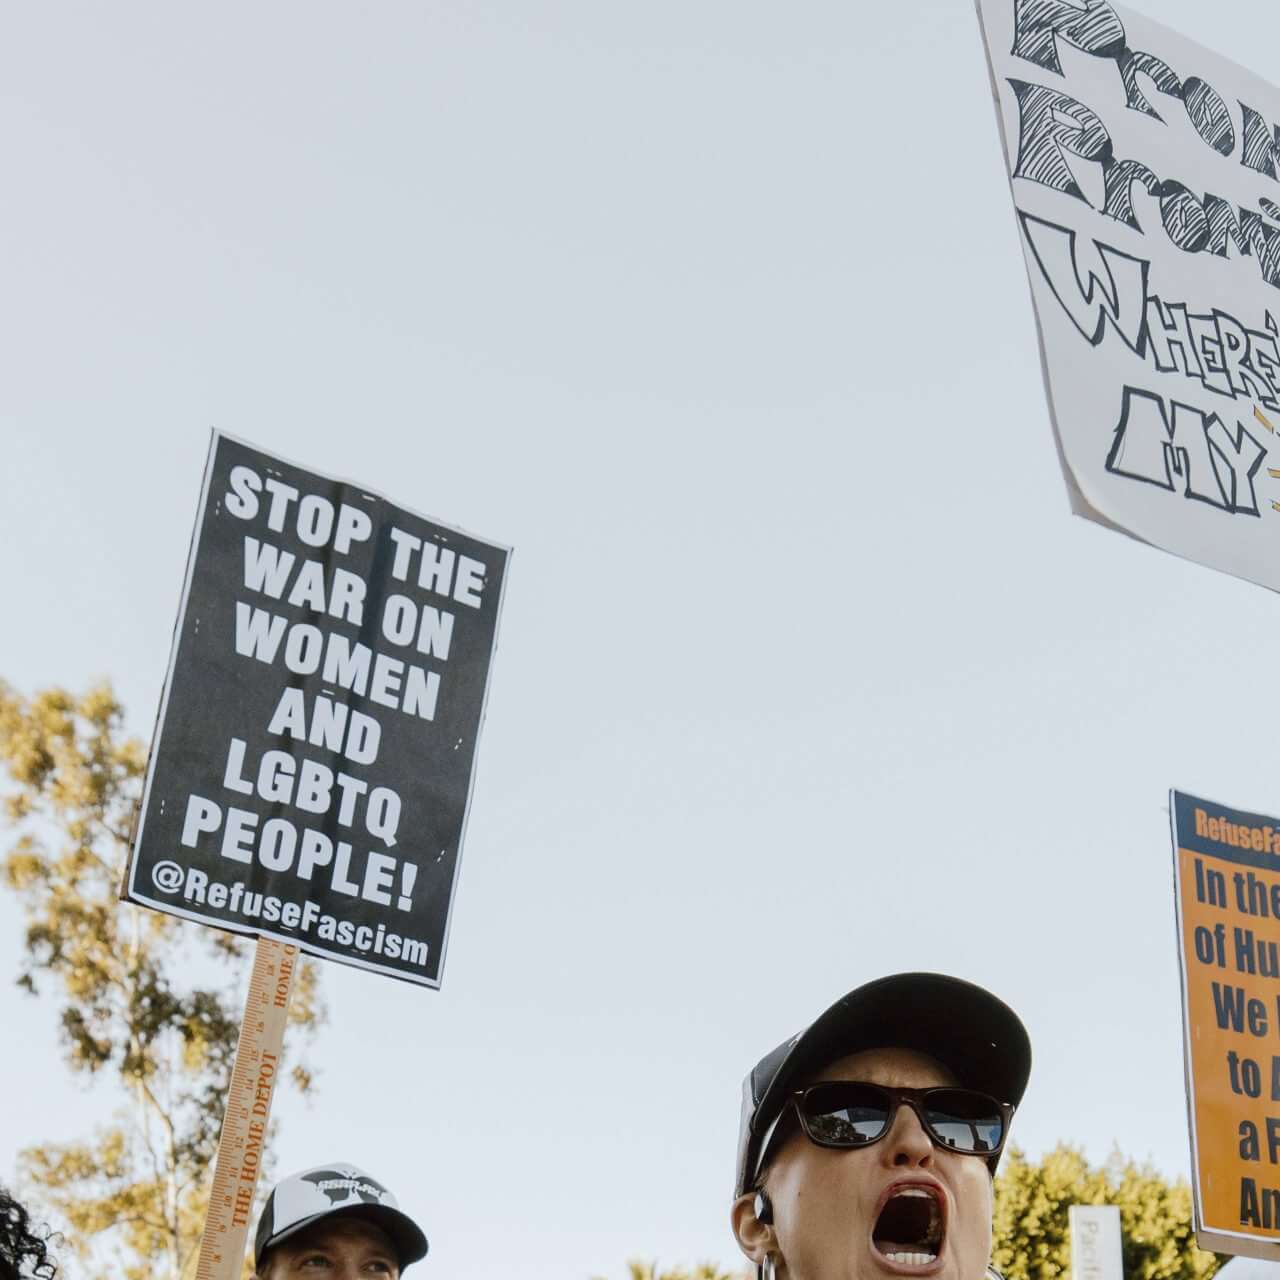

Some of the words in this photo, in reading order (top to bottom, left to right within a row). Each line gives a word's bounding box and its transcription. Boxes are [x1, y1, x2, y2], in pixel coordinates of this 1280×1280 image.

[1105, 384, 1269, 517] MY
[224, 464, 373, 555] STOP
[389, 526, 486, 609] THE
[243, 535, 368, 627] WAR
[382, 594, 456, 661] ON
[234, 601, 441, 721] WOMEN
[267, 686, 383, 766] AND
[223, 737, 403, 847] LGBTQ
[180, 794, 419, 912] PEOPLE!
[1194, 858, 1226, 908] In
[151, 859, 429, 966] @RefuseFascism
[1194, 924, 1226, 968] of
[274, 960, 294, 1008] HOME
[1212, 981, 1268, 1038] We
[252, 1050, 277, 1117] DEPOT
[1227, 1049, 1261, 1099] to
[240, 1121, 264, 1183] HOME
[1238, 1119, 1260, 1162] a
[231, 1187, 252, 1228] THE
